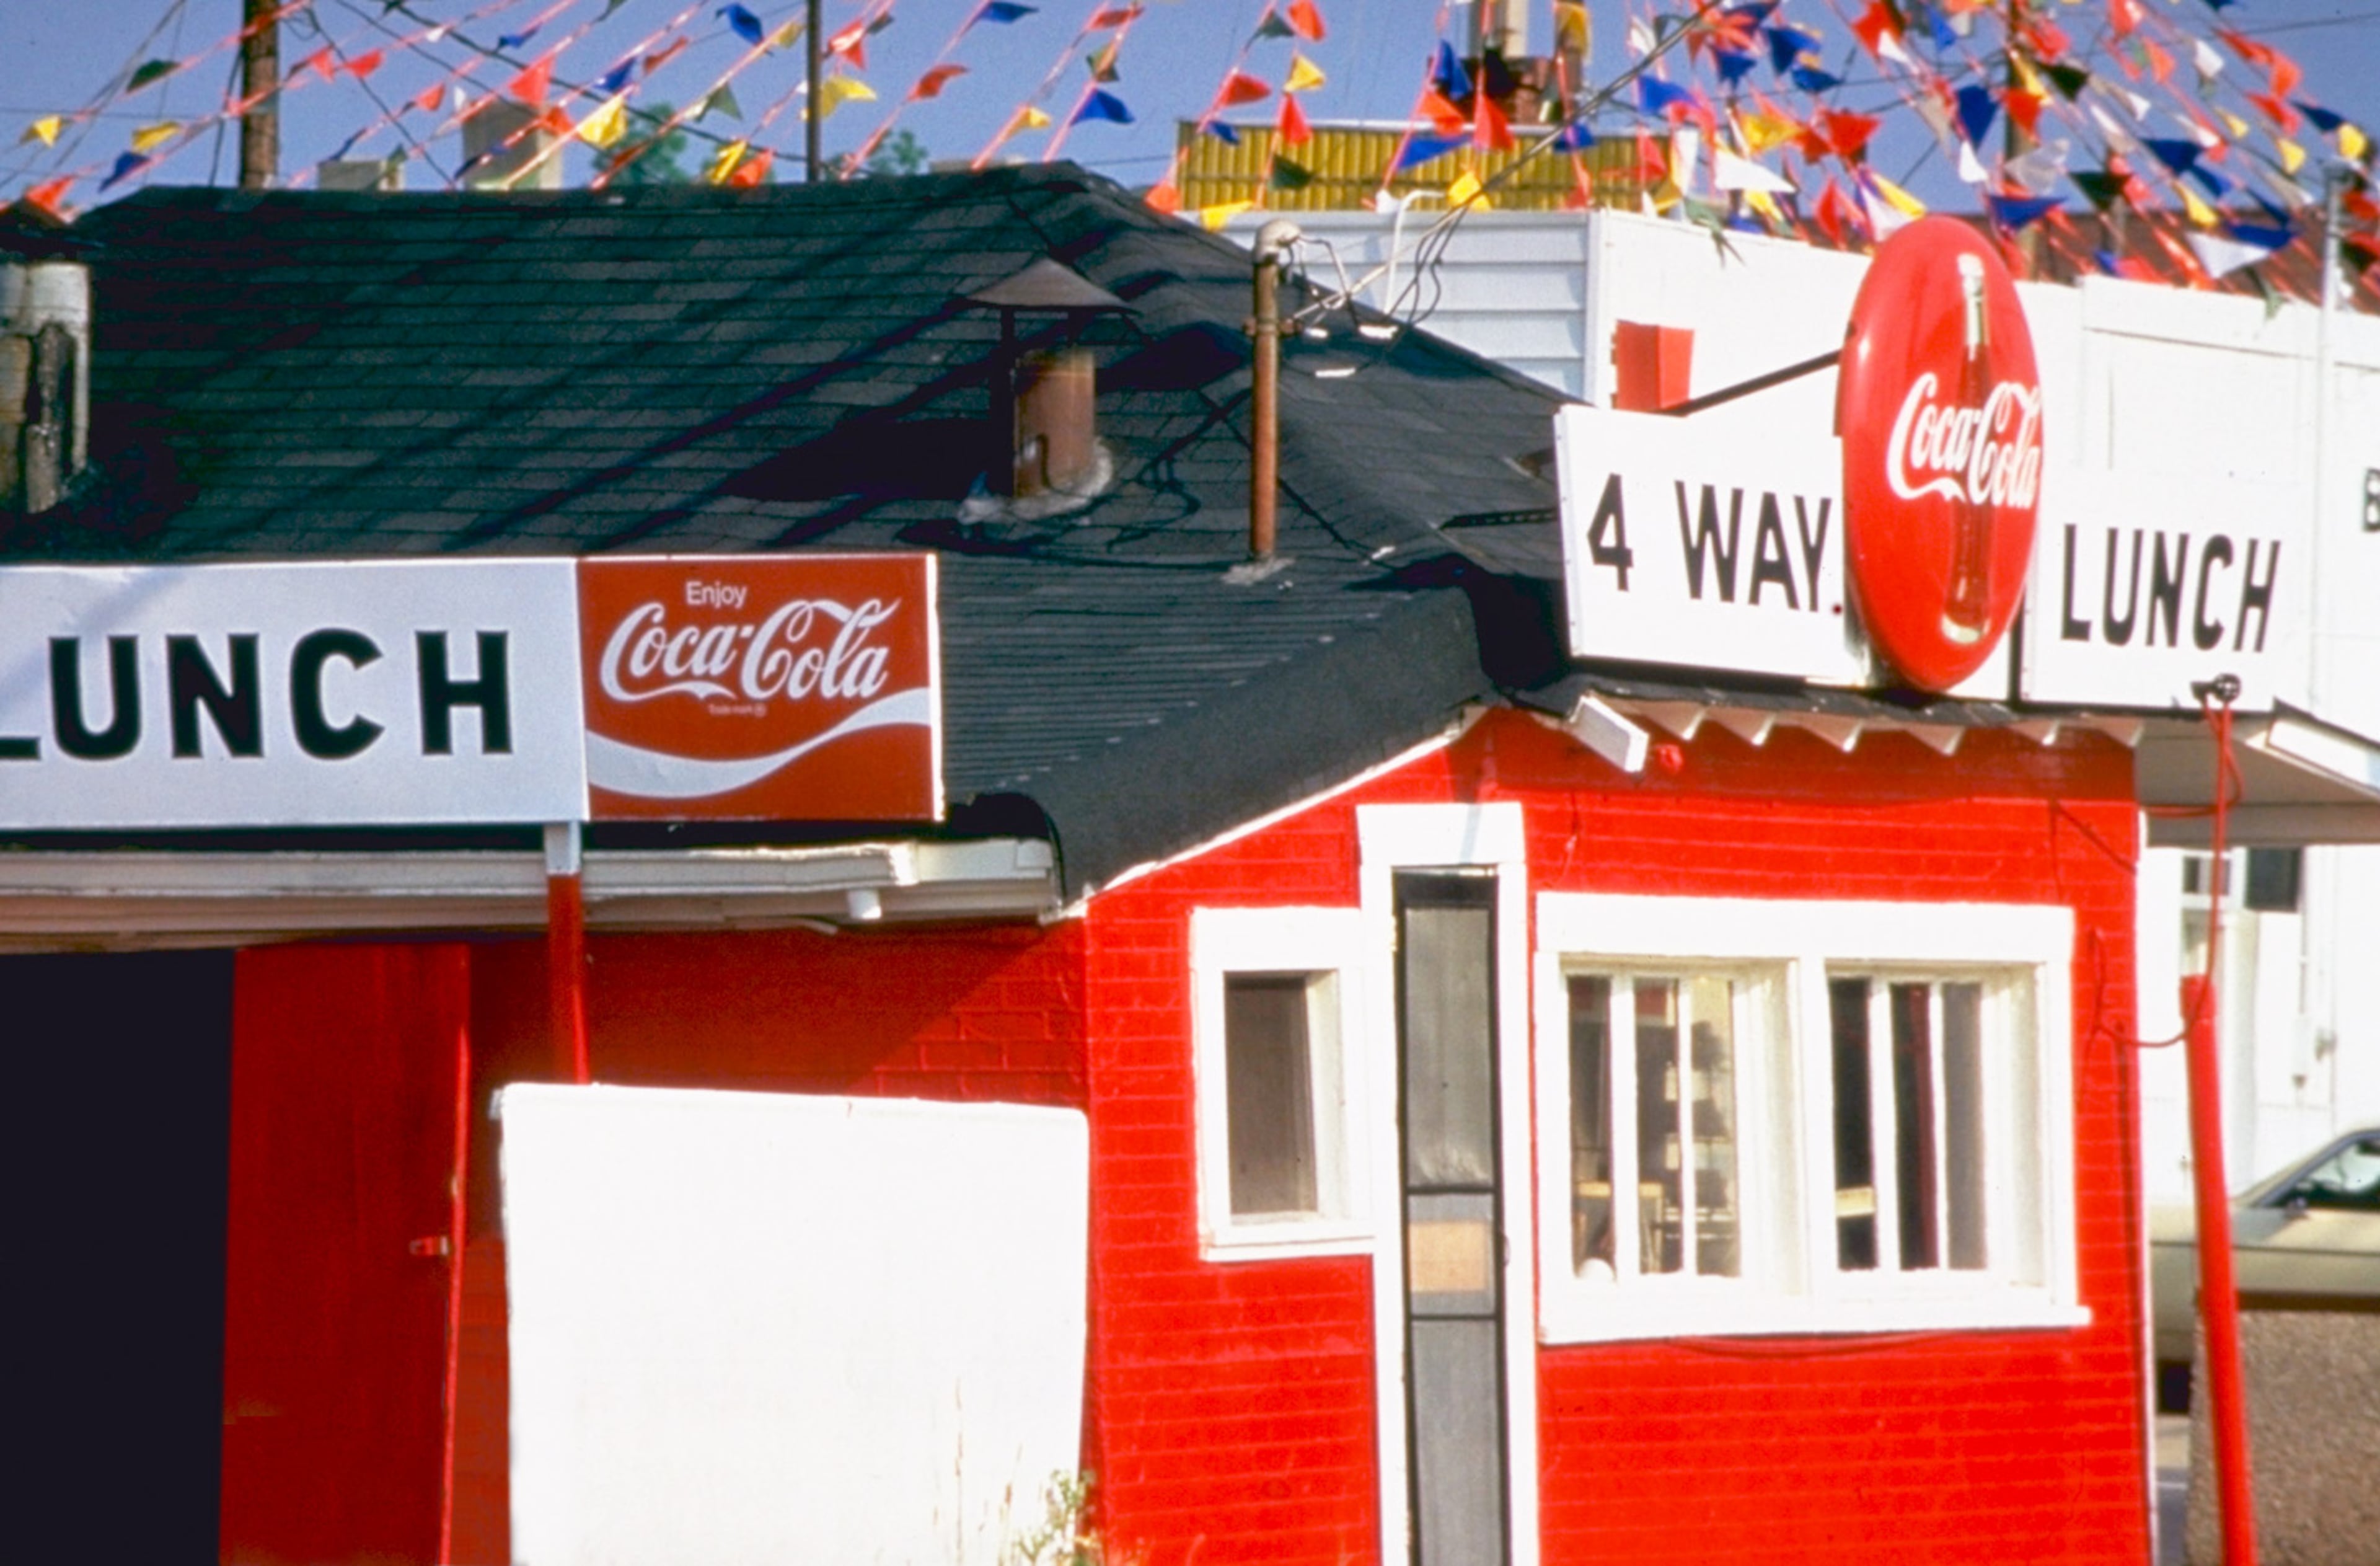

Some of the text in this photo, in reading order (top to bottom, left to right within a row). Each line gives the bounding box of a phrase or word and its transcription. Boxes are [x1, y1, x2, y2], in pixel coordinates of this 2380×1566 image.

[685, 582, 747, 609] Enjoy
[1587, 473, 1832, 613] 4 WAY
[2061, 523, 2281, 653] LUNCH
